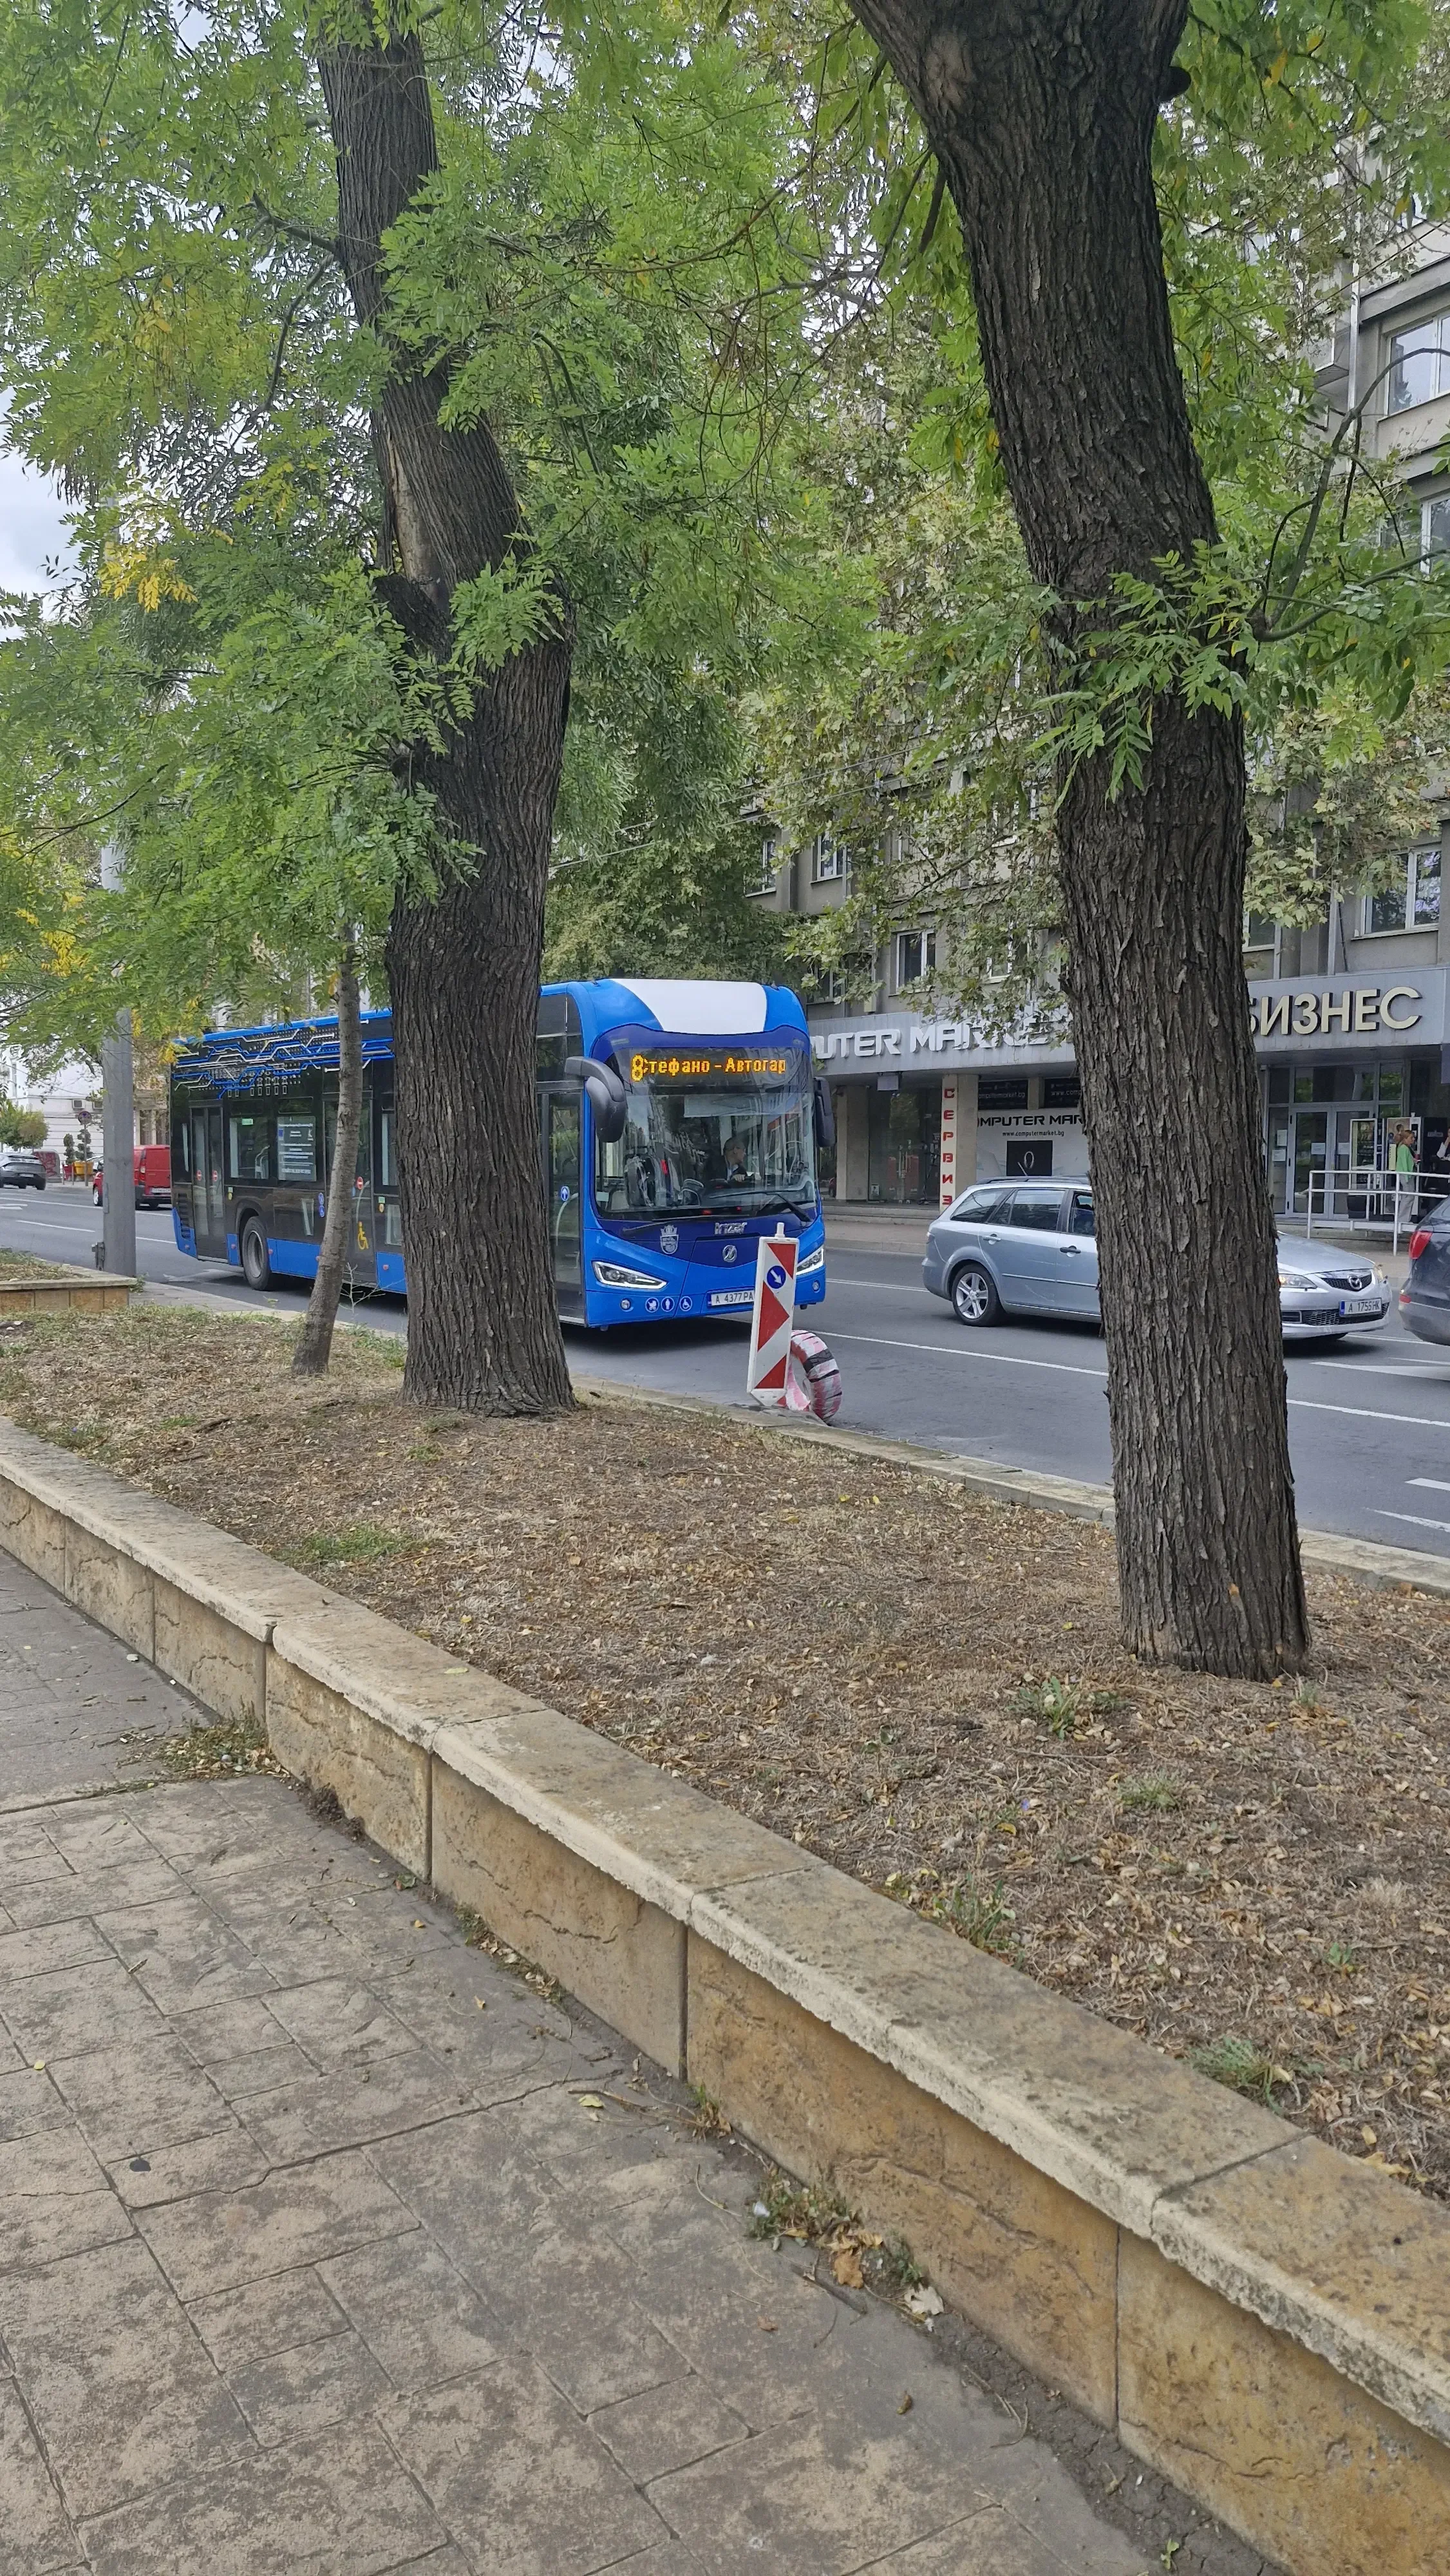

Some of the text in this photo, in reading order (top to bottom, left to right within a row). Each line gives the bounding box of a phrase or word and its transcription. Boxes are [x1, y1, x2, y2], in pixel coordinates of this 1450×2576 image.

[632, 1054, 644, 1081] 8
[724, 1057, 786, 1074] Автогар
[977, 1115, 1045, 1127] MPUTER
[942, 1088, 956, 1206] СЕРВИЗ
